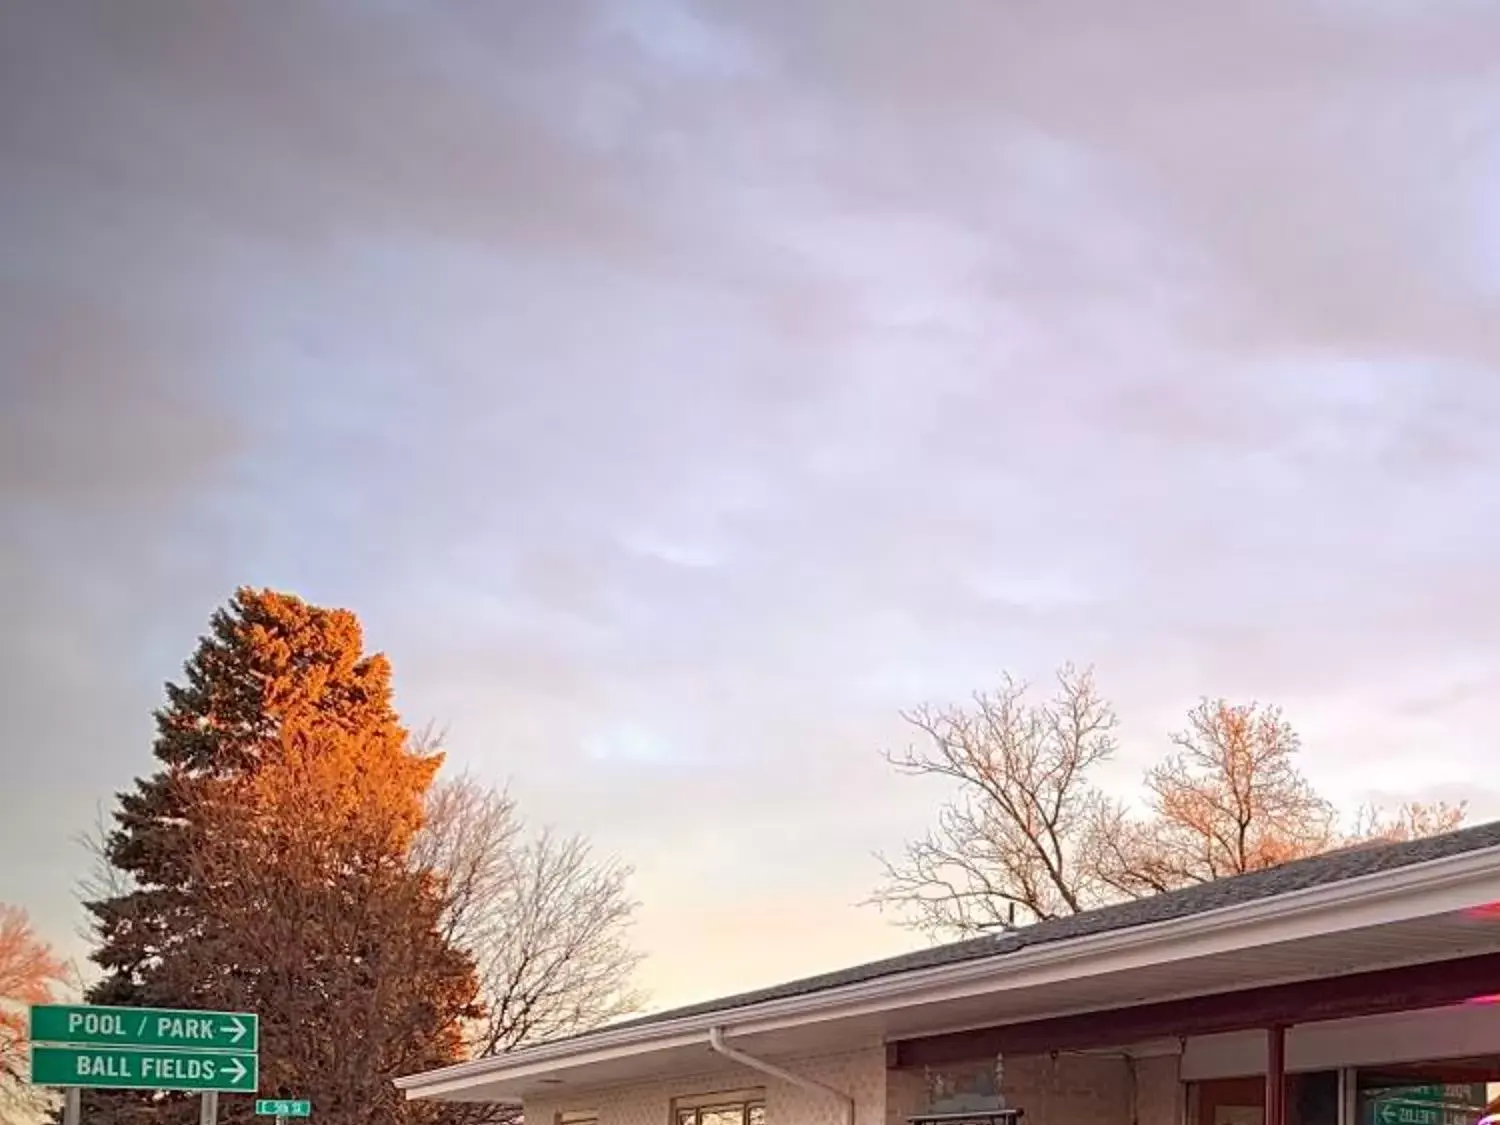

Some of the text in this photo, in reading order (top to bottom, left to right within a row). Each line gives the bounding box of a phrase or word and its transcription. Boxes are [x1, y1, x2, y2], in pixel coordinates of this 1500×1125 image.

[68, 1012, 126, 1036] POOL
[157, 1016, 214, 1039] PARK
[76, 1055, 216, 1080] BALL FIELDS
